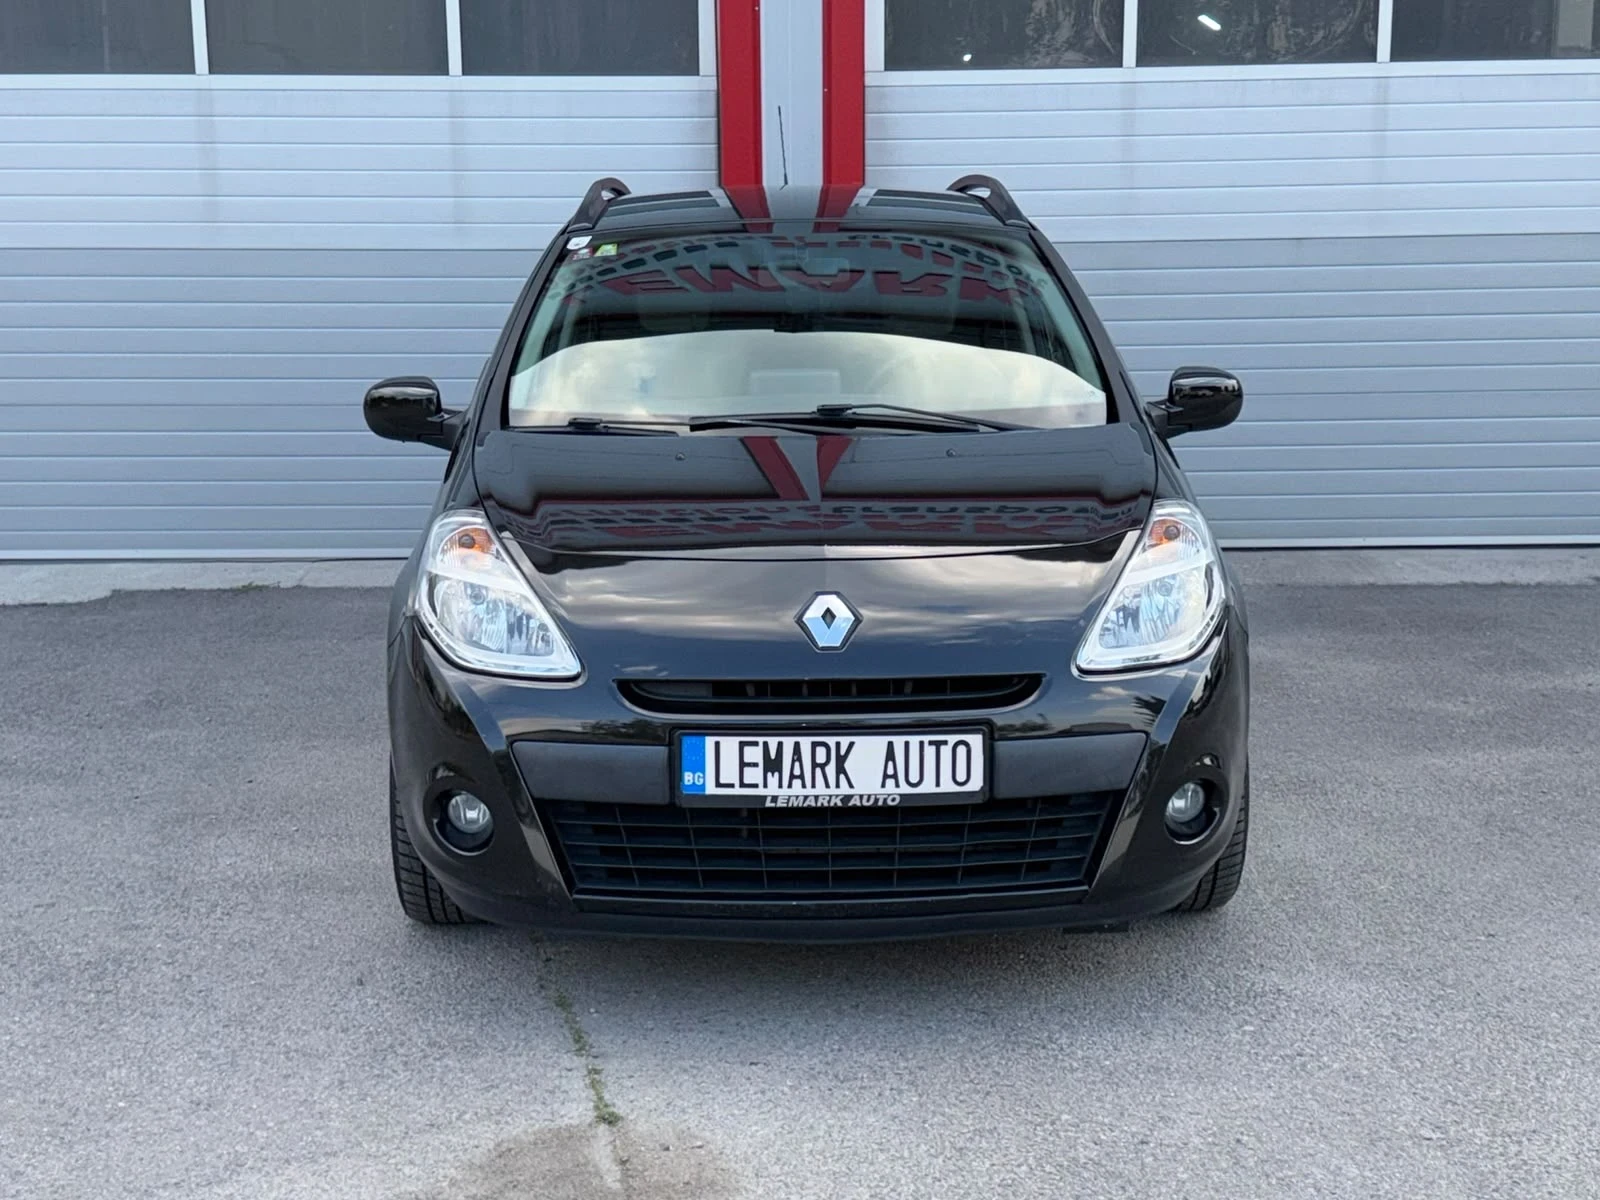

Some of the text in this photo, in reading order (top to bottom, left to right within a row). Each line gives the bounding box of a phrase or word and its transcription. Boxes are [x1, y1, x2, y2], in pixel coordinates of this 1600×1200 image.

[714, 739, 972, 789] LEMARK AUTO
[684, 772, 704, 785] BG
[765, 794, 901, 808] LEMARK AUTO
